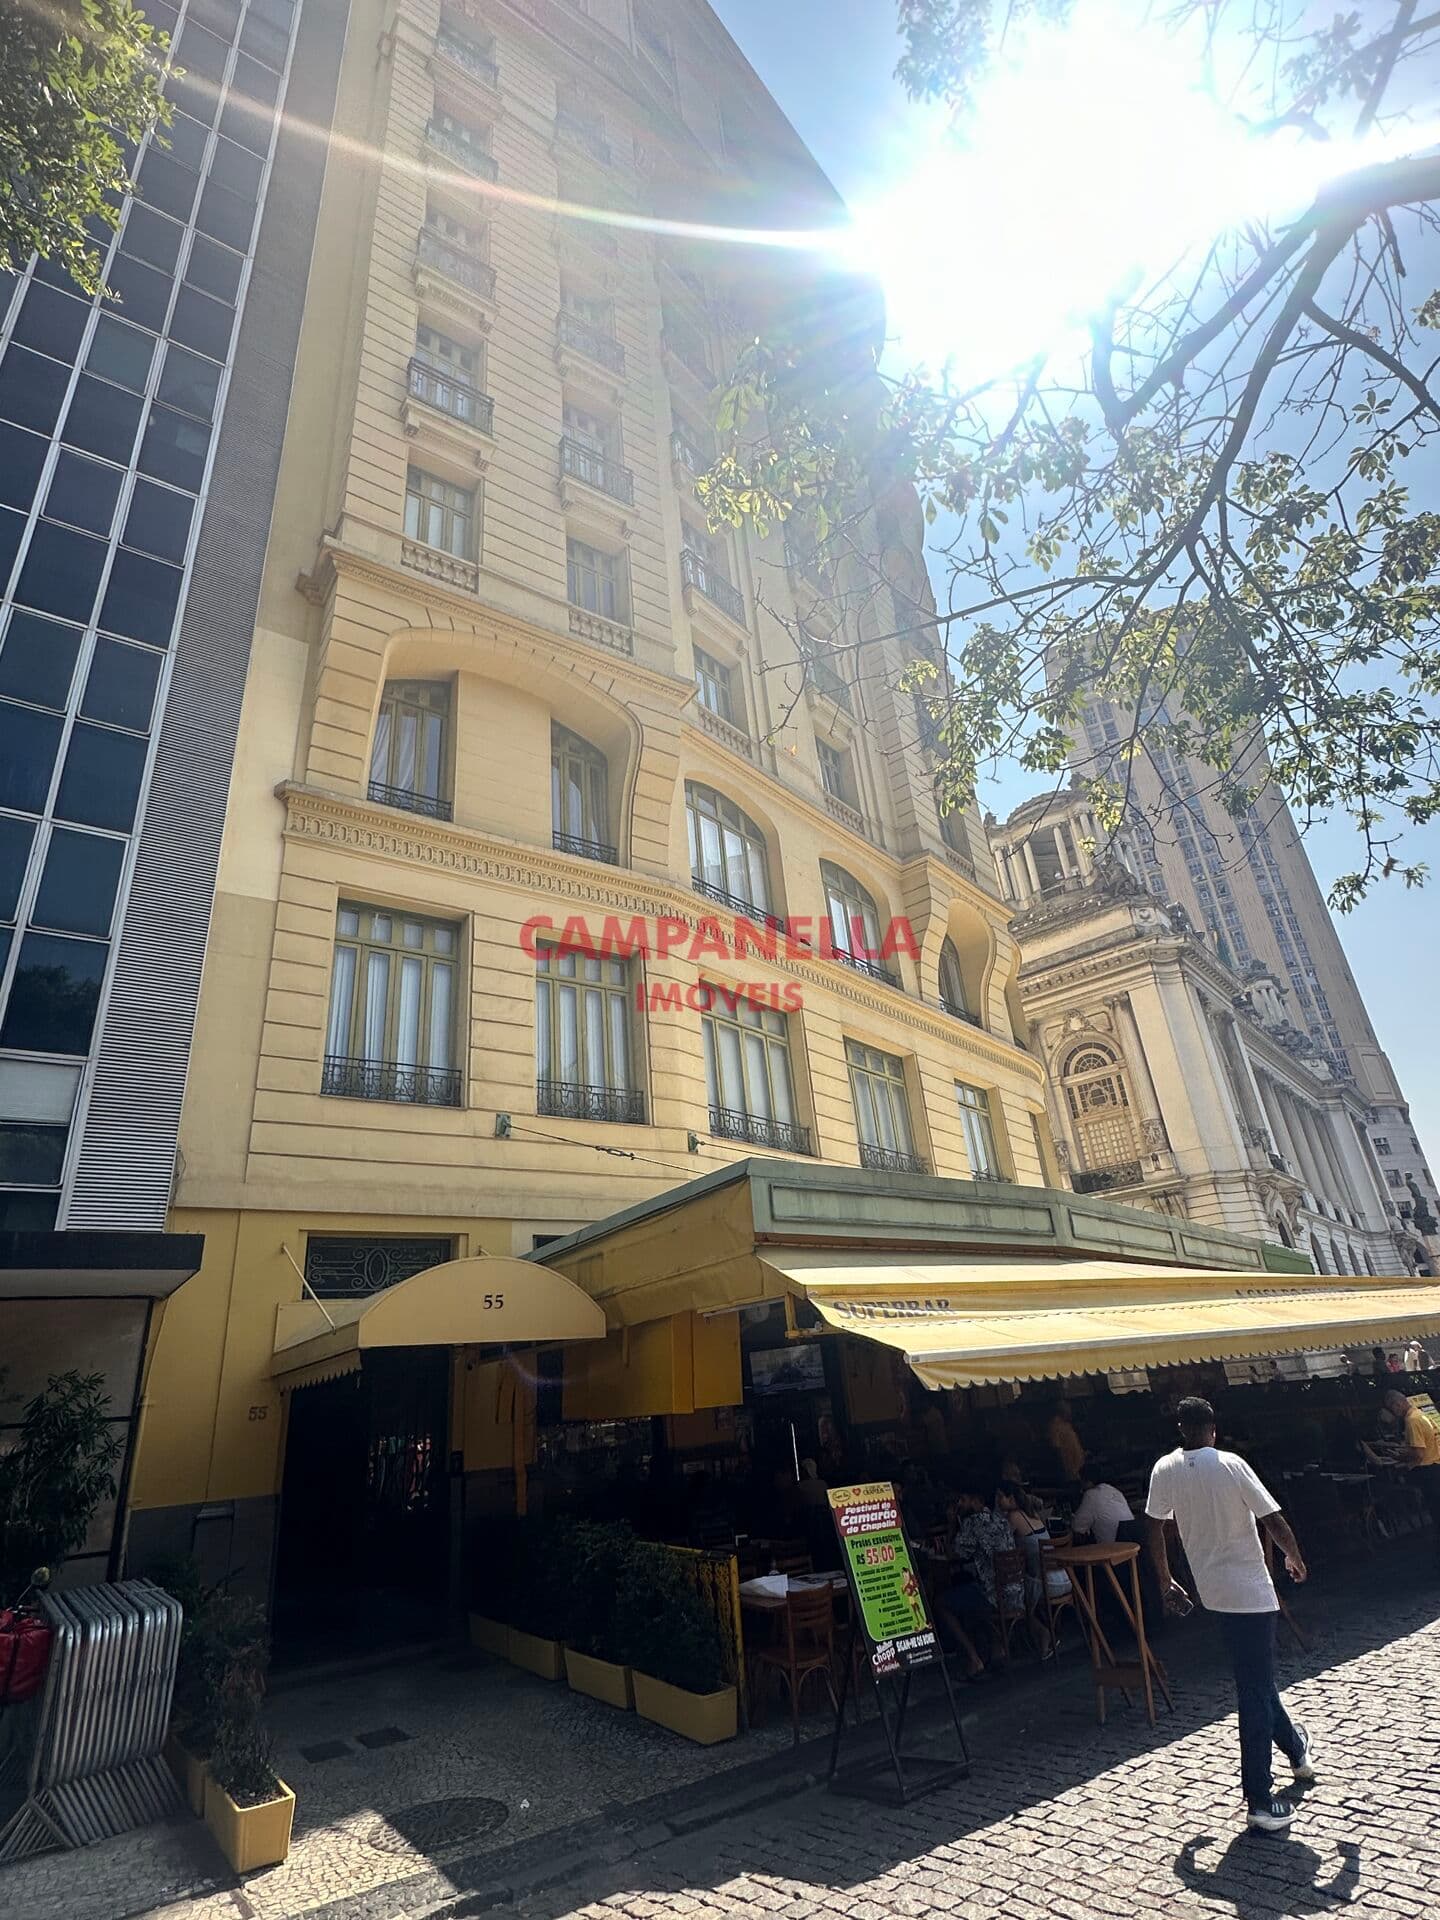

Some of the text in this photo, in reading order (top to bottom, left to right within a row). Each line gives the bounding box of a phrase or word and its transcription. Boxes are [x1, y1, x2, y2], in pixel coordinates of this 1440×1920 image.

[483, 1294, 505, 1311] 55
[248, 1406, 269, 1421] 55
[845, 1503, 880, 1514] Festival
[841, 1509, 897, 1526] Camarão
[861, 1520, 896, 1532] Chapolin
[872, 1646, 896, 1666] Chopp
